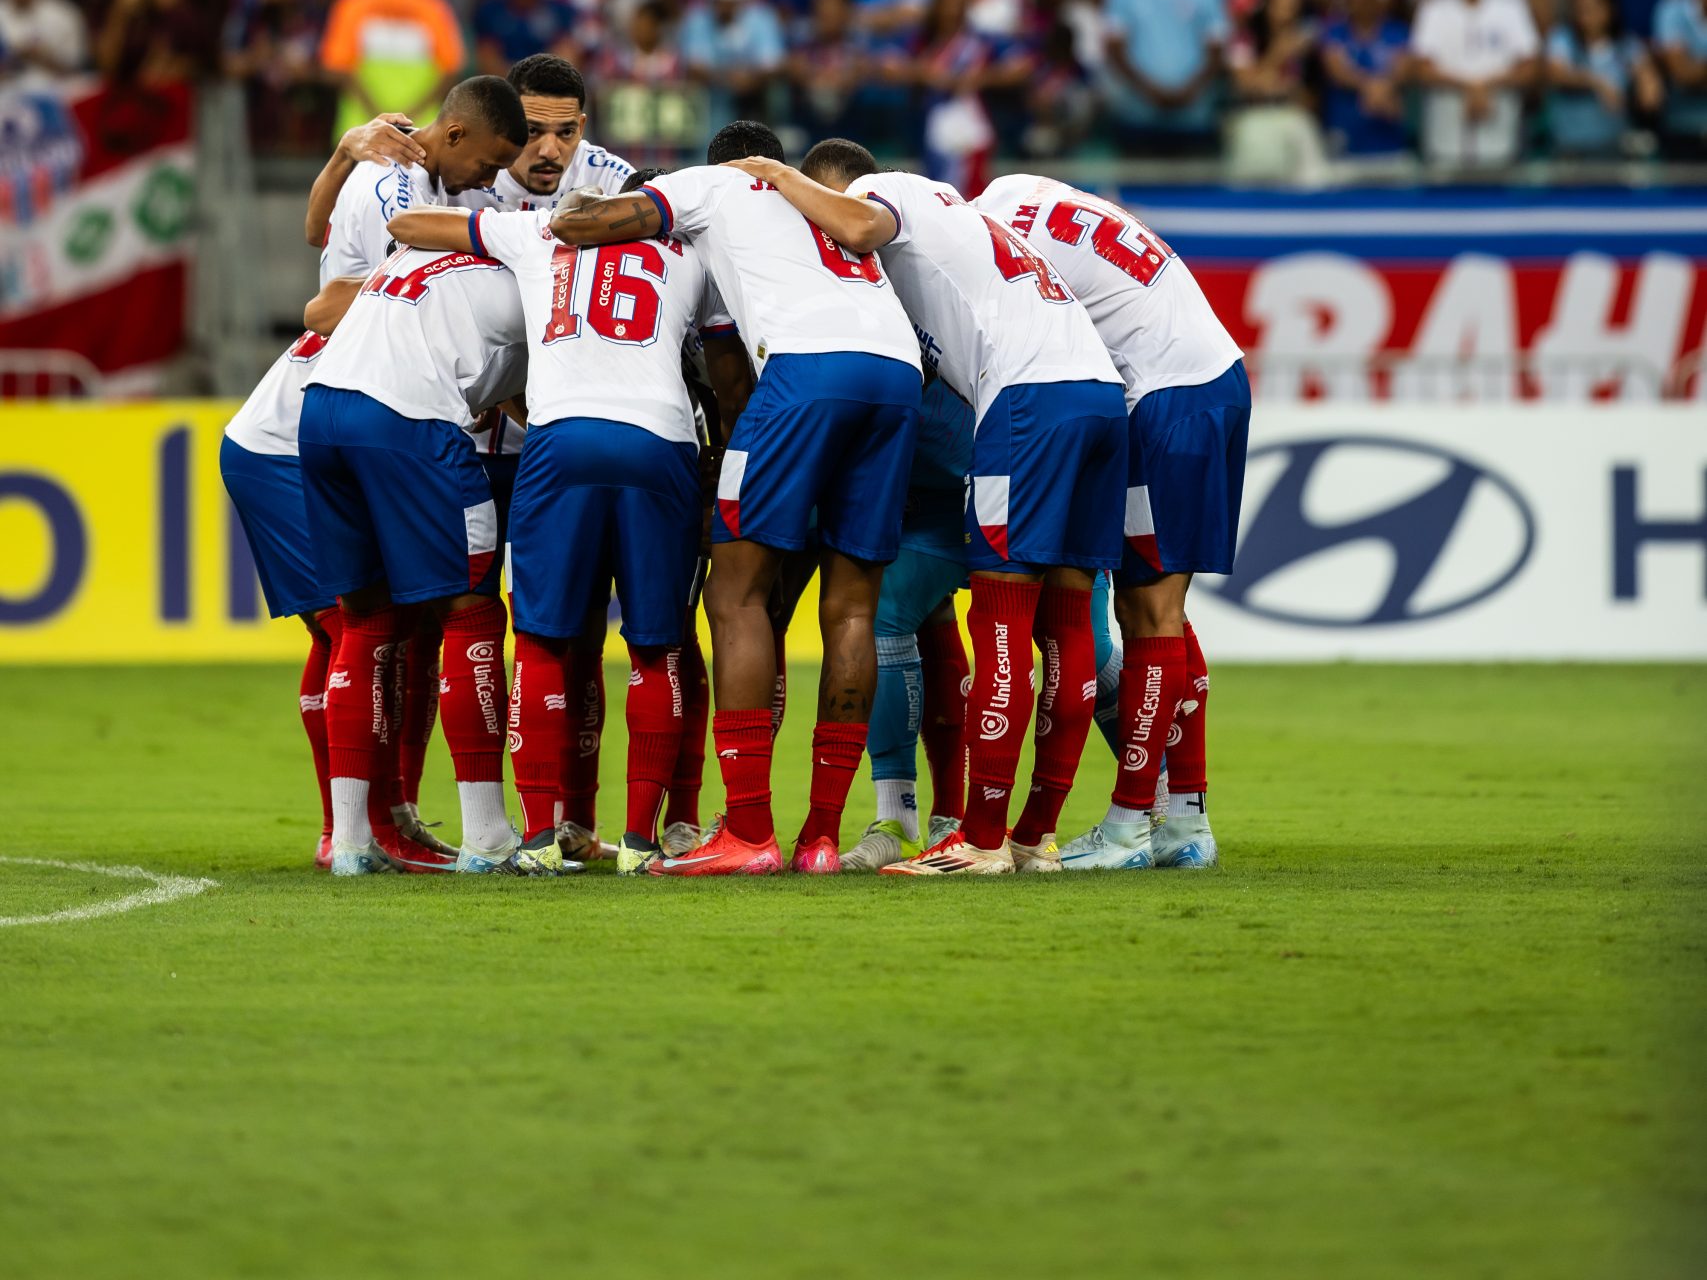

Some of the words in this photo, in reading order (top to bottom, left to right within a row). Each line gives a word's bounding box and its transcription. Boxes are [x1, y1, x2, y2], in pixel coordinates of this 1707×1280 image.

[423, 254, 475, 275] acelen
[542, 241, 668, 348] 16
[557, 262, 571, 309] acelen
[599, 261, 616, 307] acelen
[1243, 251, 1700, 402] BAH
[372, 665, 386, 736] UniCesumar
[474, 664, 499, 736] UniCesumar
[509, 661, 523, 728] UniCesumar
[667, 652, 683, 719] UniCesumar
[990, 622, 1012, 708] UniCesumar
[1042, 636, 1060, 711] UniCesumar
[584, 680, 599, 727] UniCes
[1132, 665, 1162, 742] UniCesumar
